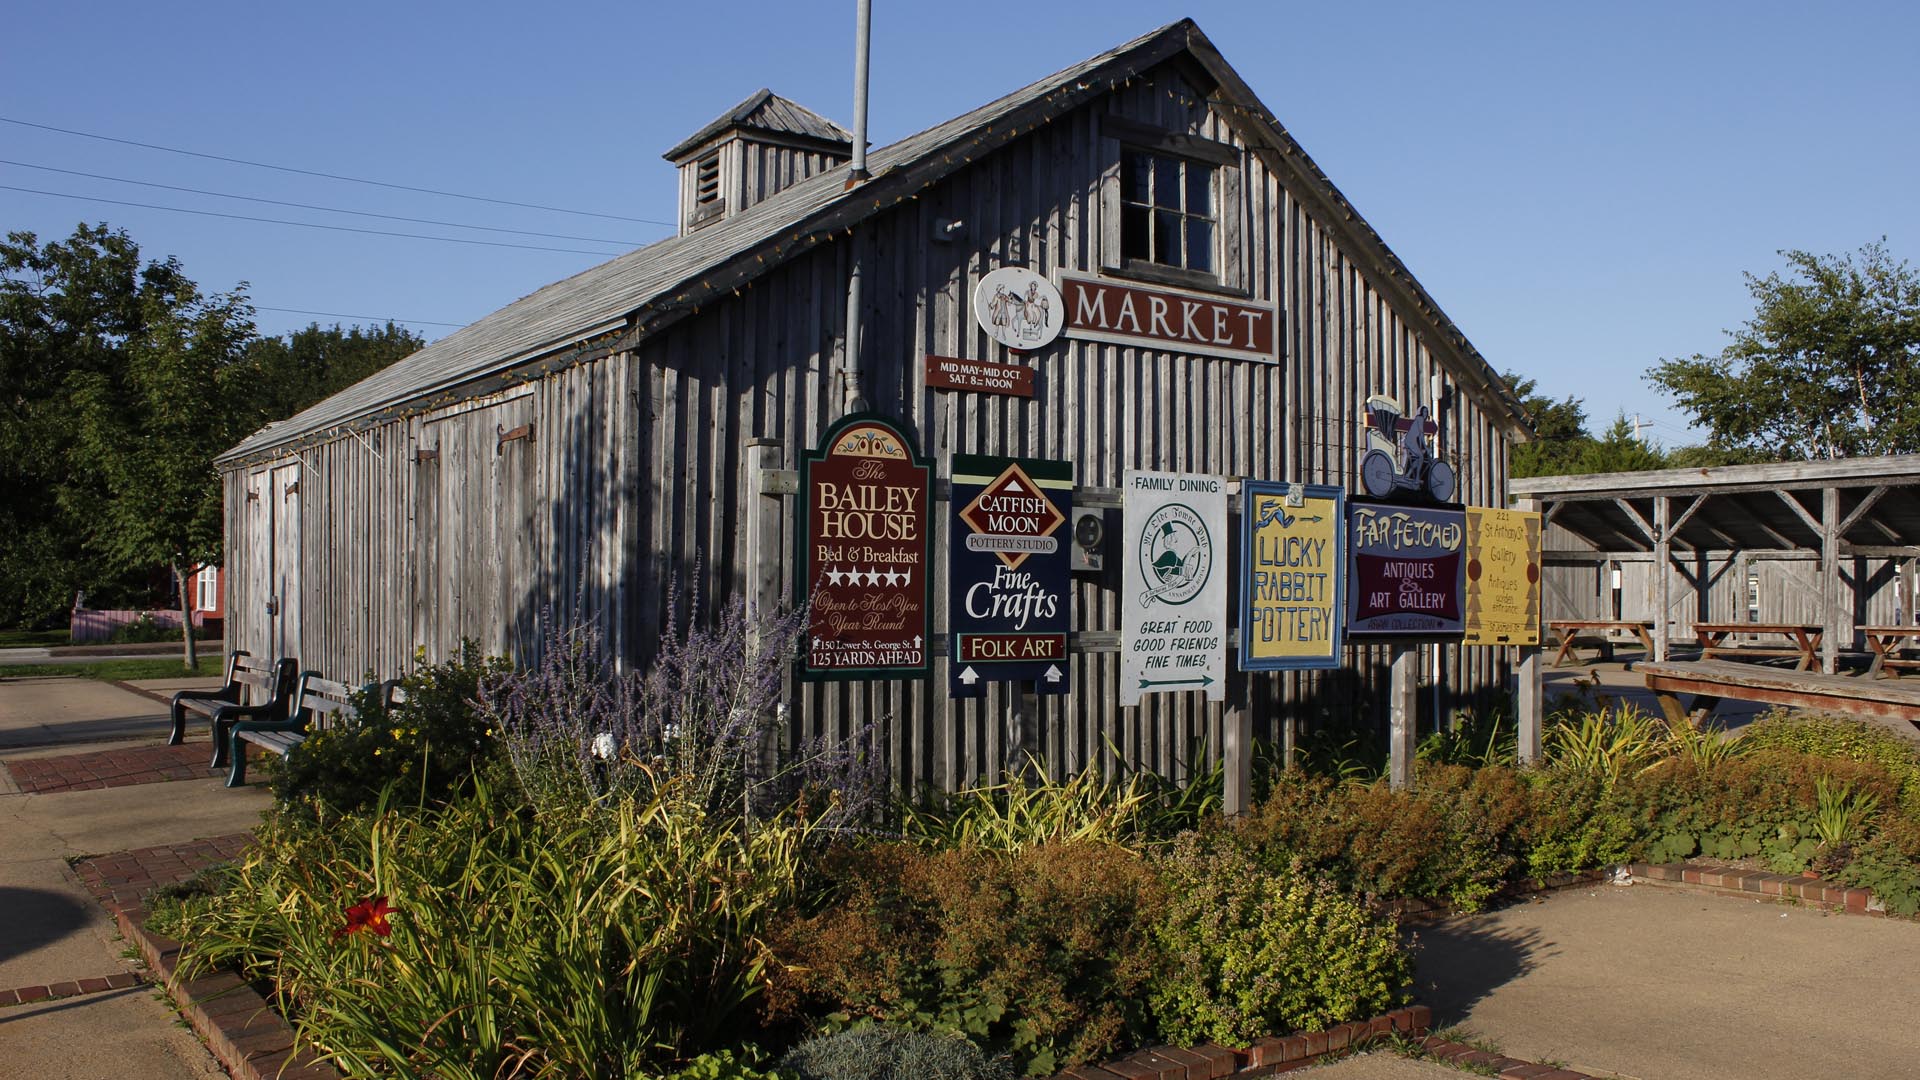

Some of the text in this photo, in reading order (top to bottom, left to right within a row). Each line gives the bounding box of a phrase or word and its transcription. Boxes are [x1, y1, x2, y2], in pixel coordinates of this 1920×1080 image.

[1074, 285, 1263, 349] MARKET
[940, 362, 959, 373] MID
[949, 373, 968, 385] SAT.
[985, 378, 1013, 389] NOON
[852, 460, 887, 480] The
[1135, 476, 1219, 493] FAMILY DINING
[817, 482, 920, 513] BAILEY
[979, 494, 1047, 515] CATFISH
[819, 510, 917, 541] HOUSE
[988, 514, 1039, 533] MOON
[1496, 512, 1509, 520] 221
[970, 537, 1054, 550] POTTERY STUDIO
[1260, 536, 1326, 567] LUCKY
[817, 545, 919, 564] Bed & Breakfast
[1490, 546, 1516, 566] Gallery
[992, 564, 1031, 590] Fine
[1383, 562, 1434, 579] ANTIQUES
[1254, 572, 1327, 601] RABBIT
[1400, 578, 1422, 593] &
[1488, 574, 1518, 592] Antiques
[815, 590, 919, 618] Open to Host You
[965, 581, 1058, 631] Crafts
[1369, 592, 1446, 609] ART GALLERY
[829, 612, 904, 636] Year Round
[1140, 620, 1213, 634] GREAT FOOD
[1252, 606, 1332, 642] POTTERY
[821, 640, 912, 650] 150 Lower St. George St.
[972, 637, 1055, 657] FOLK ART
[1133, 637, 1218, 652] GOOD FRIENDS
[812, 650, 922, 666] 125 YARDS AHEAD
[1145, 654, 1207, 669] FINE TIMES
